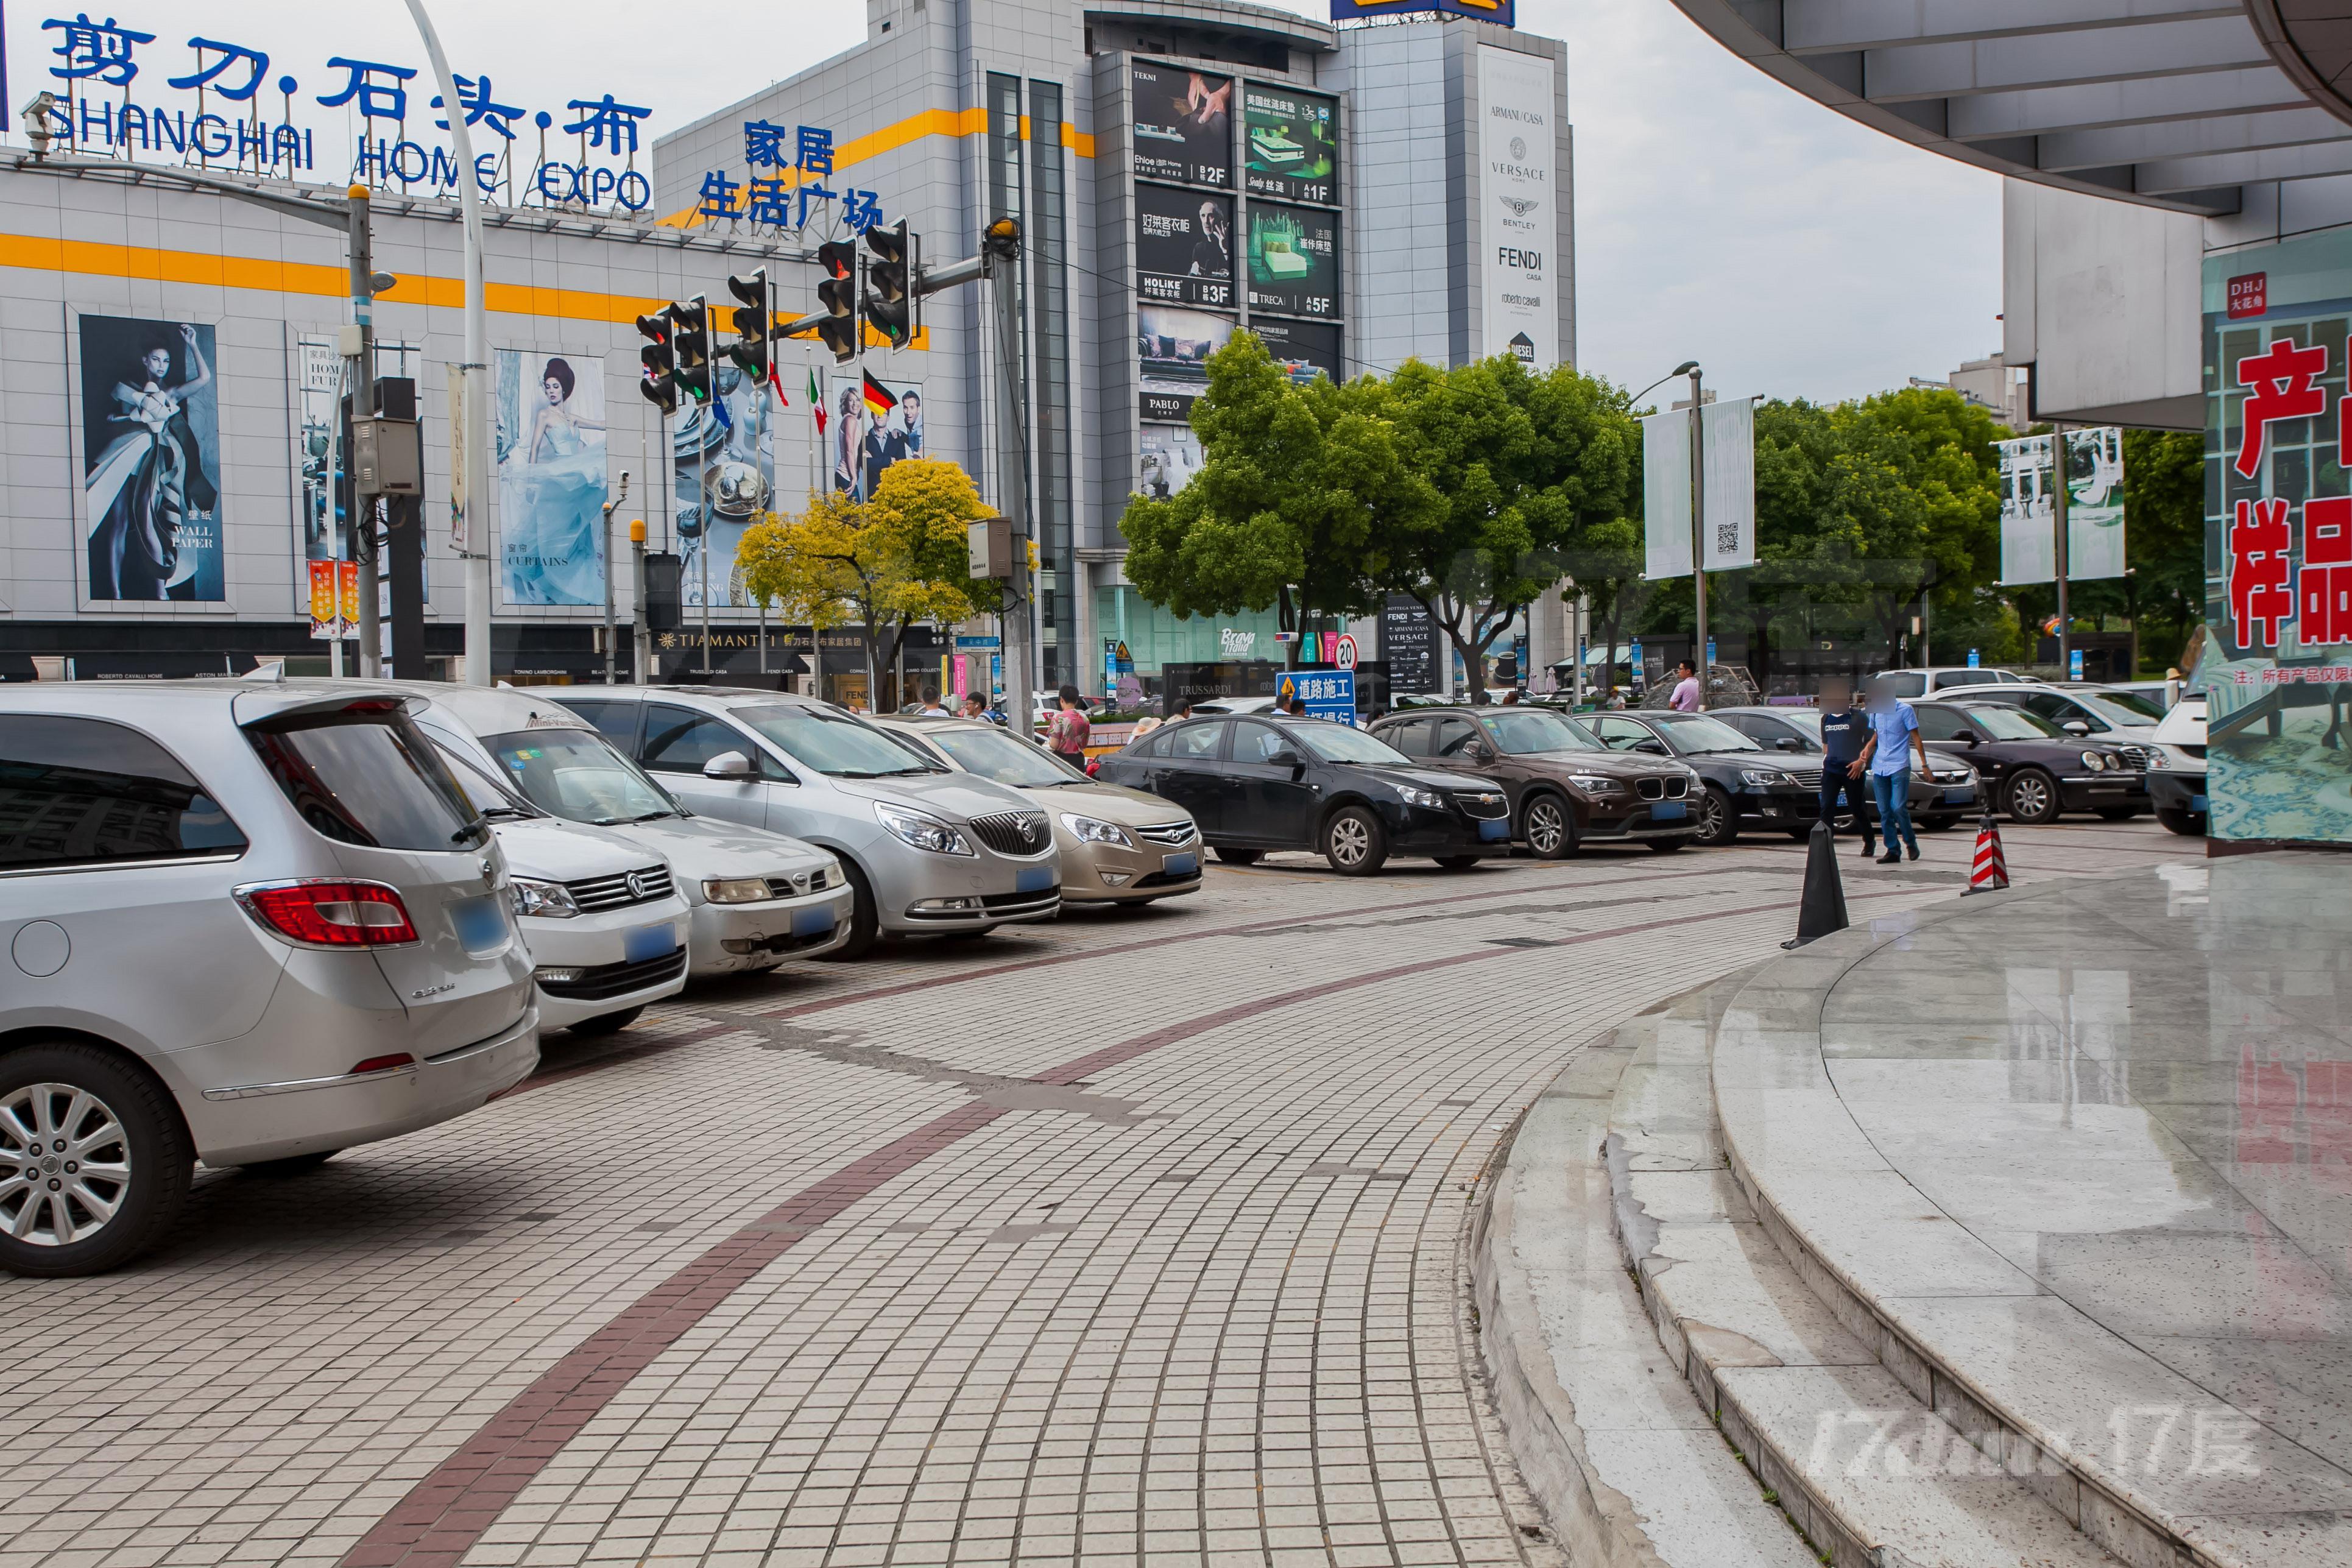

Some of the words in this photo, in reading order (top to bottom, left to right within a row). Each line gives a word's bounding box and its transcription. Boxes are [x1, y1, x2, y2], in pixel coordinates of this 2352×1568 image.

[1134, 71, 1156, 82] TEKNI
[51, 96, 313, 171] SHANGHAI
[358, 135, 496, 192] HOME
[537, 161, 651, 211] EXPO
[744, 119, 835, 175] 家居
[1207, 167, 1225, 183] 2F
[1492, 162, 1545, 181] VERSACE
[1310, 185, 1327, 201] 1F
[699, 170, 883, 236] 生活广场
[1142, 213, 1190, 233] 好莱客衣柜
[1503, 219, 1536, 230] BENTLEY
[1315, 228, 1332, 241] 法国
[1499, 247, 1541, 270] FENDI
[1209, 285, 1229, 303] 3F
[2230, 279, 2264, 296] DHJ
[1259, 294, 1284, 306] TRECA
[1313, 298, 1330, 313] 5F
[1502, 292, 1522, 305] roberto
[1522, 297, 1541, 307] cavalli
[1511, 344, 1533, 358] DIESEL
[311, 364, 339, 375] HOM
[312, 375, 337, 386] FUR
[1149, 399, 1180, 410] PABLO
[2234, 337, 2352, 480] 产
[188, 510, 213, 521] 壁纸
[174, 525, 213, 537] WALL
[171, 537, 213, 548] PAPER
[507, 543, 528, 553] 窗帘
[508, 556, 569, 567] CURTAINS
[687, 583, 724, 592] LIVNG
[1221, 627, 1256, 645] Brava
[1225, 640, 1249, 652] Italia
[1340, 643, 1352, 665] 20
[2234, 667, 2352, 685] 注：所有产品仅限
[846, 691, 868, 699] FEND
[1179, 685, 1231, 696] TRUSSARDI
[1299, 678, 1350, 700] 道路施工
[529, 719, 571, 728] Mini-Van
